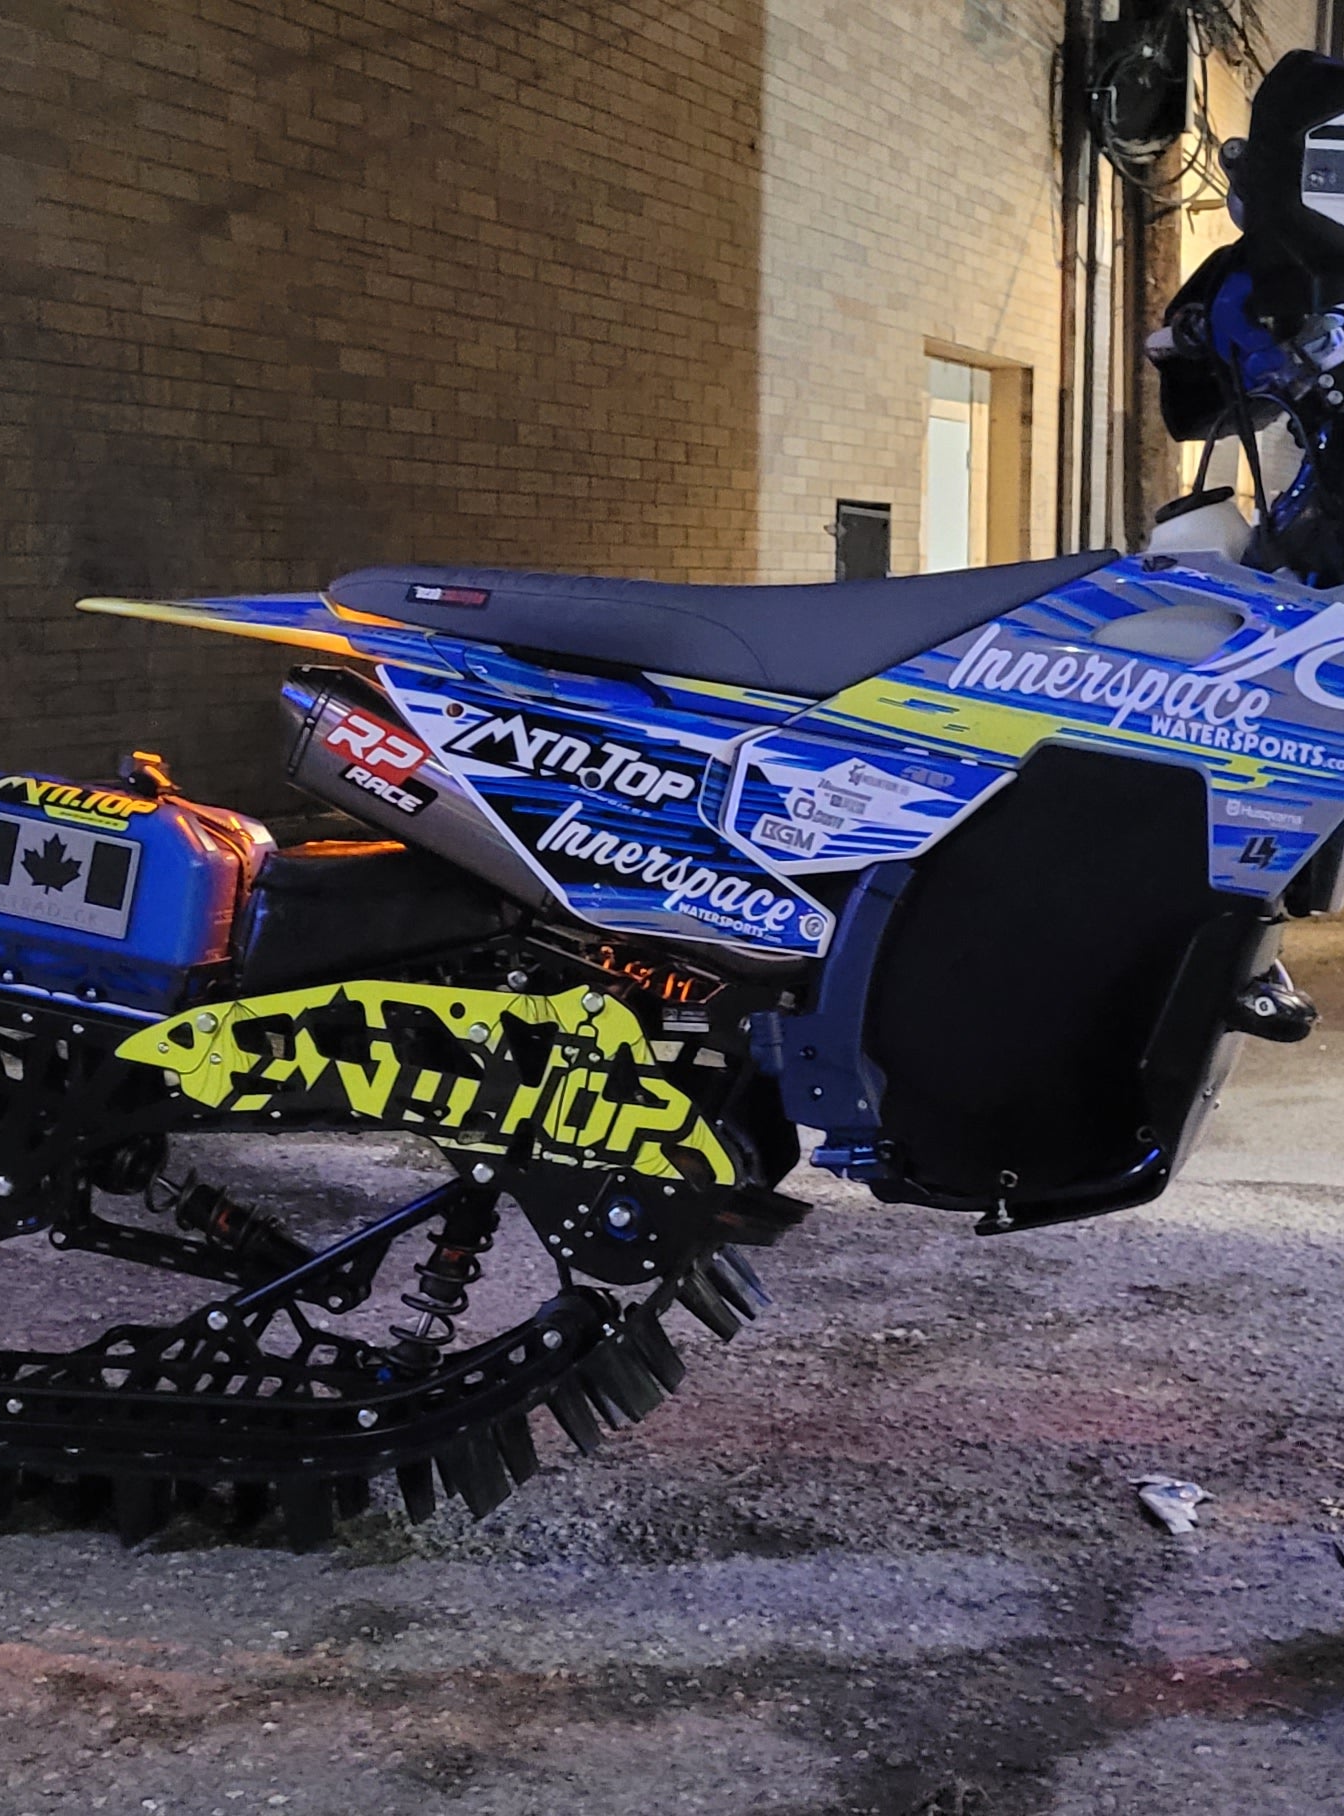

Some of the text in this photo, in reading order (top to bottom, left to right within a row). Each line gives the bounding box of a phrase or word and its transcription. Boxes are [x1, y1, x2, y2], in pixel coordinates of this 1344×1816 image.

[949, 623, 1270, 733] Innerspace
[327, 714, 424, 769] RP
[345, 765, 424, 813] RACE
[536, 800, 796, 931] Innerspace
